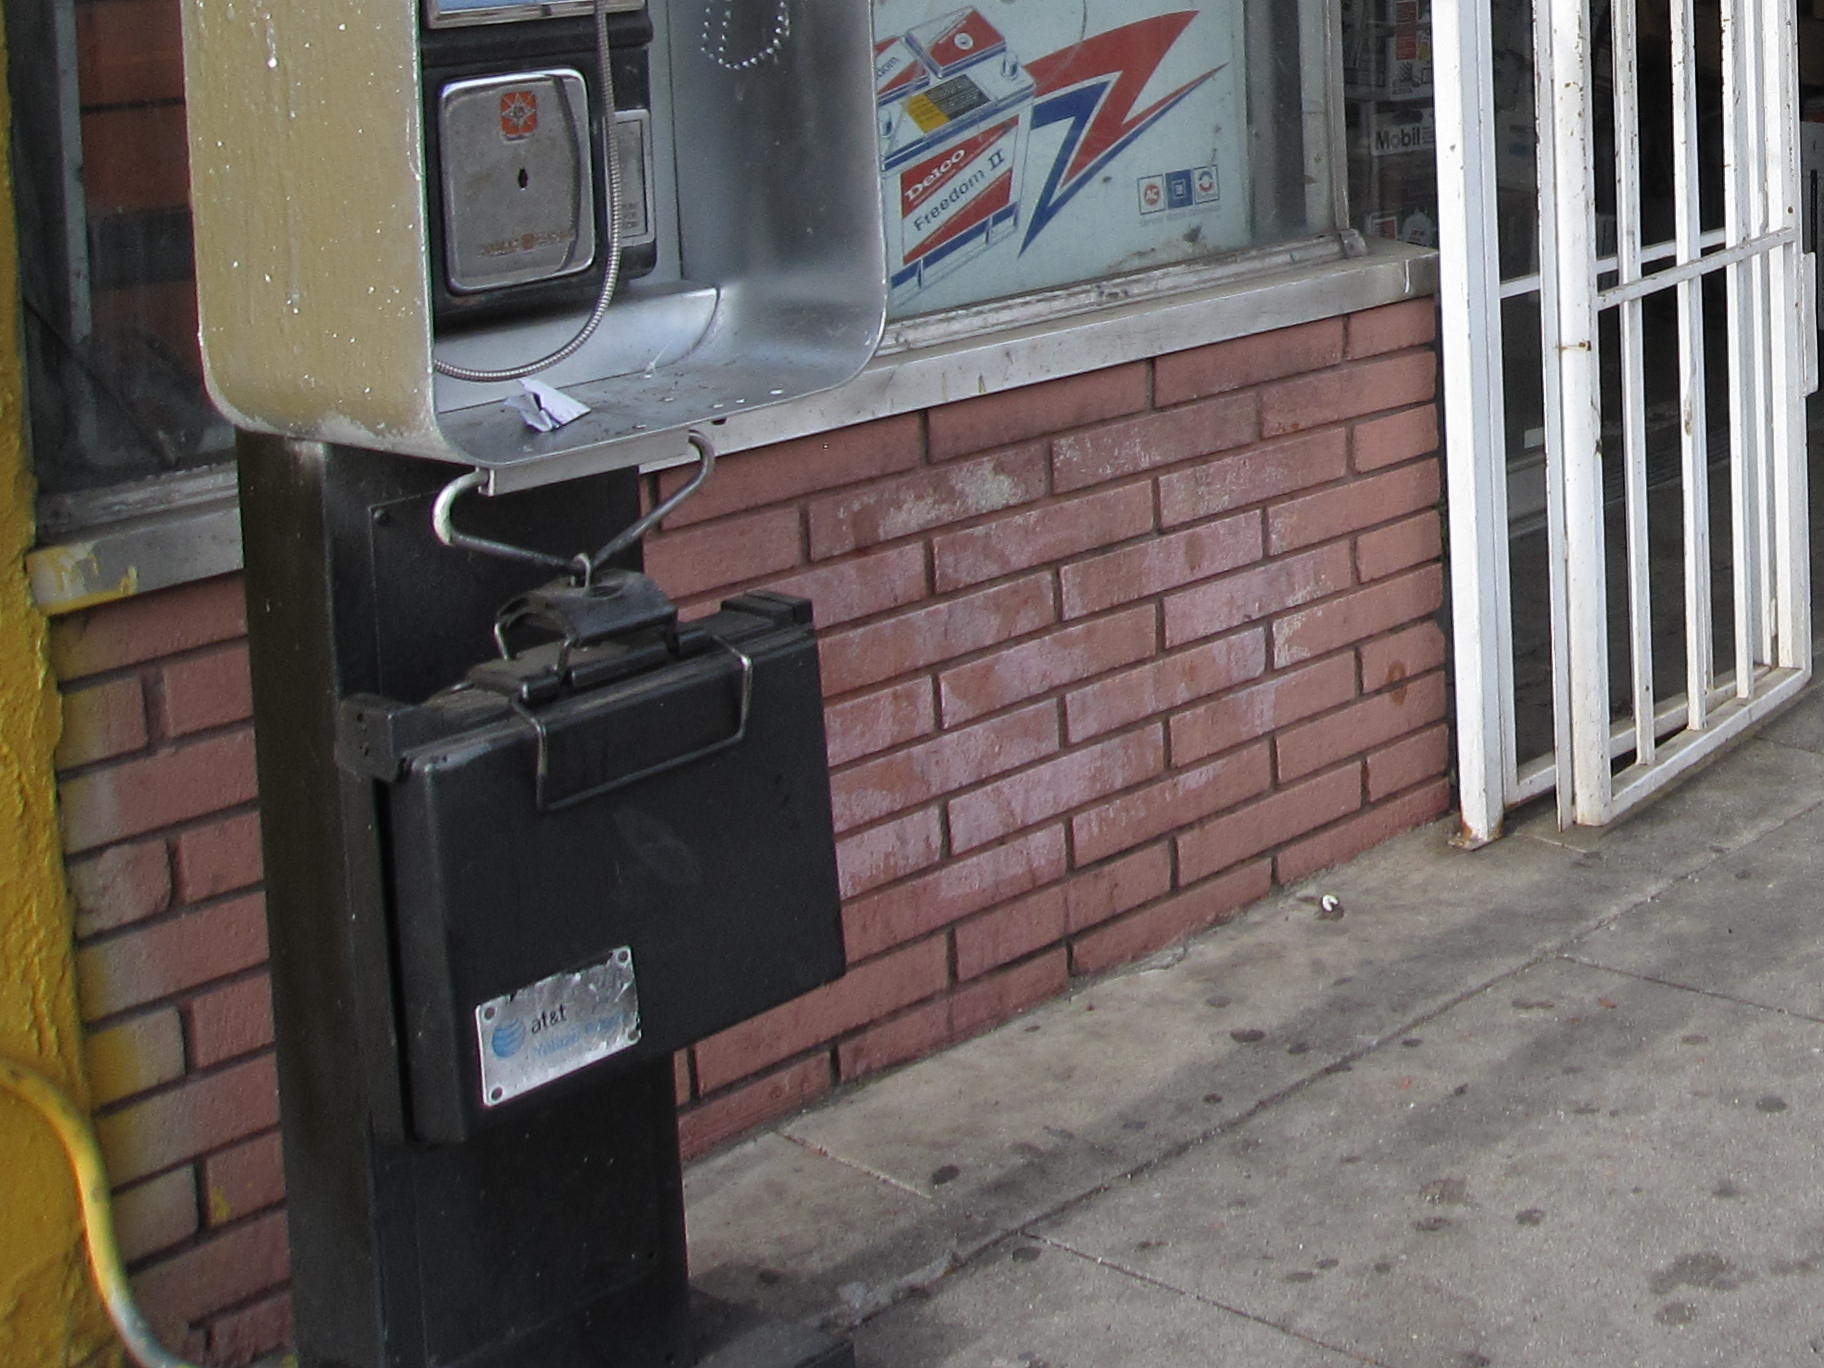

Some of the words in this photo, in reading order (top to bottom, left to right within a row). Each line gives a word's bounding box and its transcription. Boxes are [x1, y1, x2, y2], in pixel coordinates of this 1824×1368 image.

[1374, 127, 1422, 151] Mobil
[912, 166, 986, 232] Freedom
[530, 1003, 568, 1035] at&t
